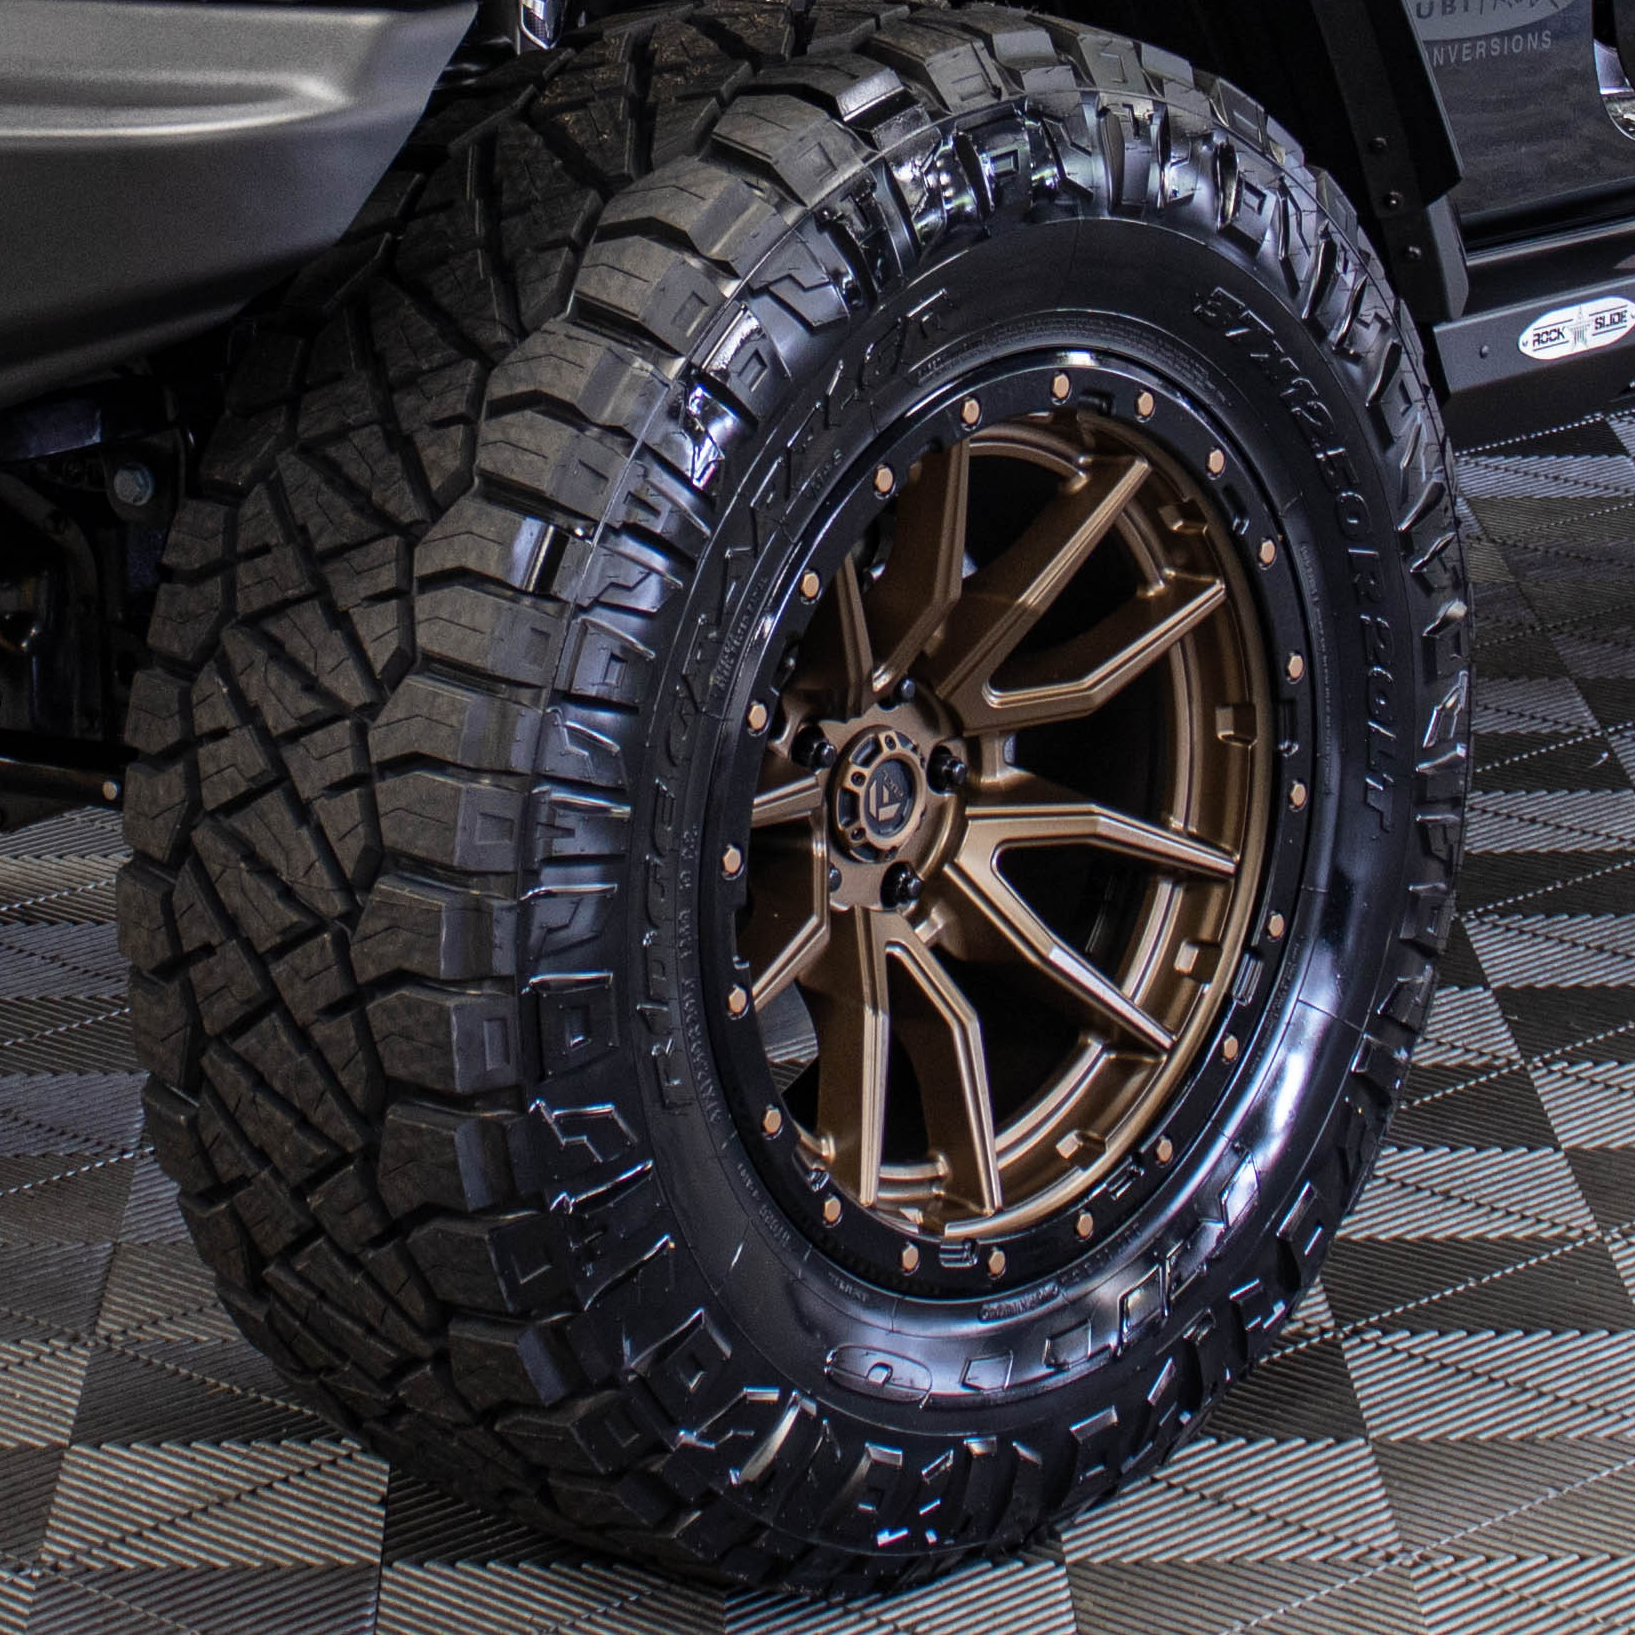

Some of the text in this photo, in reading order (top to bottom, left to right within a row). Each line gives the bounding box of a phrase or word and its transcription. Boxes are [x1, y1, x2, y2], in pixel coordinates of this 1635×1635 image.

[1425, 29, 1553, 67] NVERSIONS
[1532, 309, 1629, 347] ROCK SLIDE
